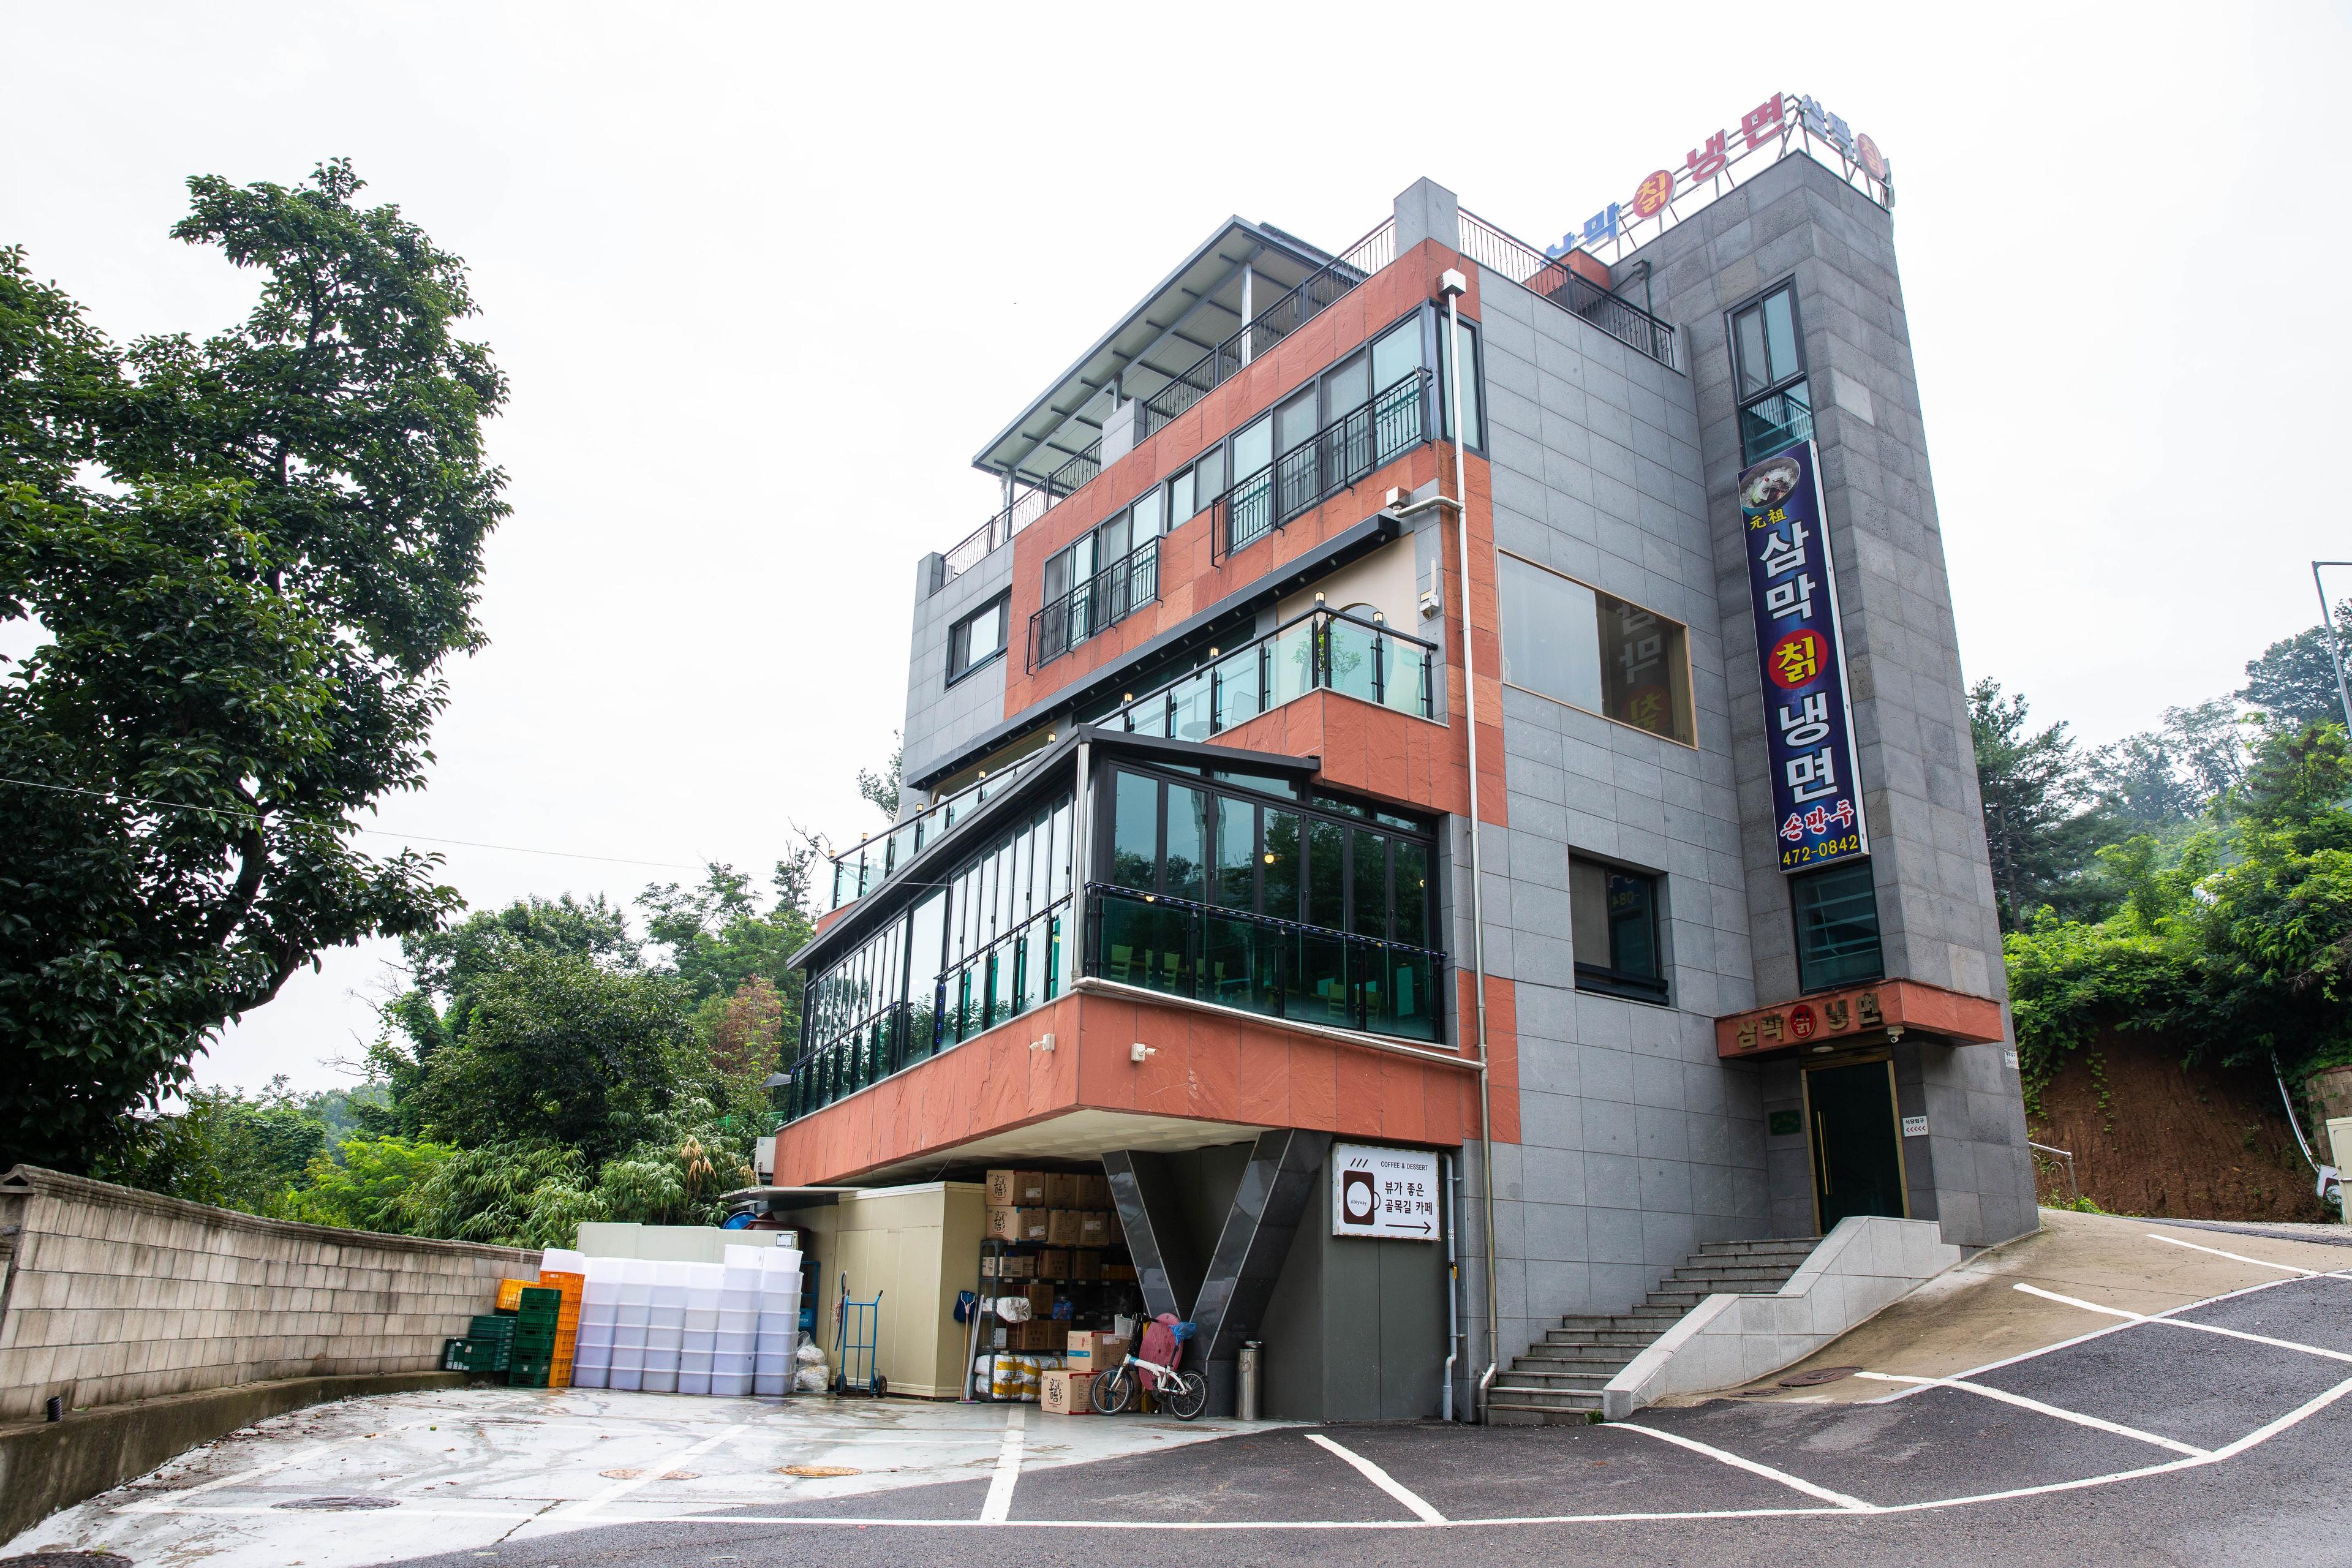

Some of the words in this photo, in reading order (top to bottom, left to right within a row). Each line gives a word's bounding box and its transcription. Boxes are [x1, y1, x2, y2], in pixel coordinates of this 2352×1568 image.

[1749, 508, 1788, 531] 元祖
[1779, 799, 1855, 842] 손만두
[1782, 834, 1859, 865] 472-0842
[1385, 1181, 1403, 1196] 뷰가
[1407, 1182, 1424, 1197] 좋은
[1385, 1199, 1411, 1214] 골목길
[1415, 1201, 1433, 1216] 카페
